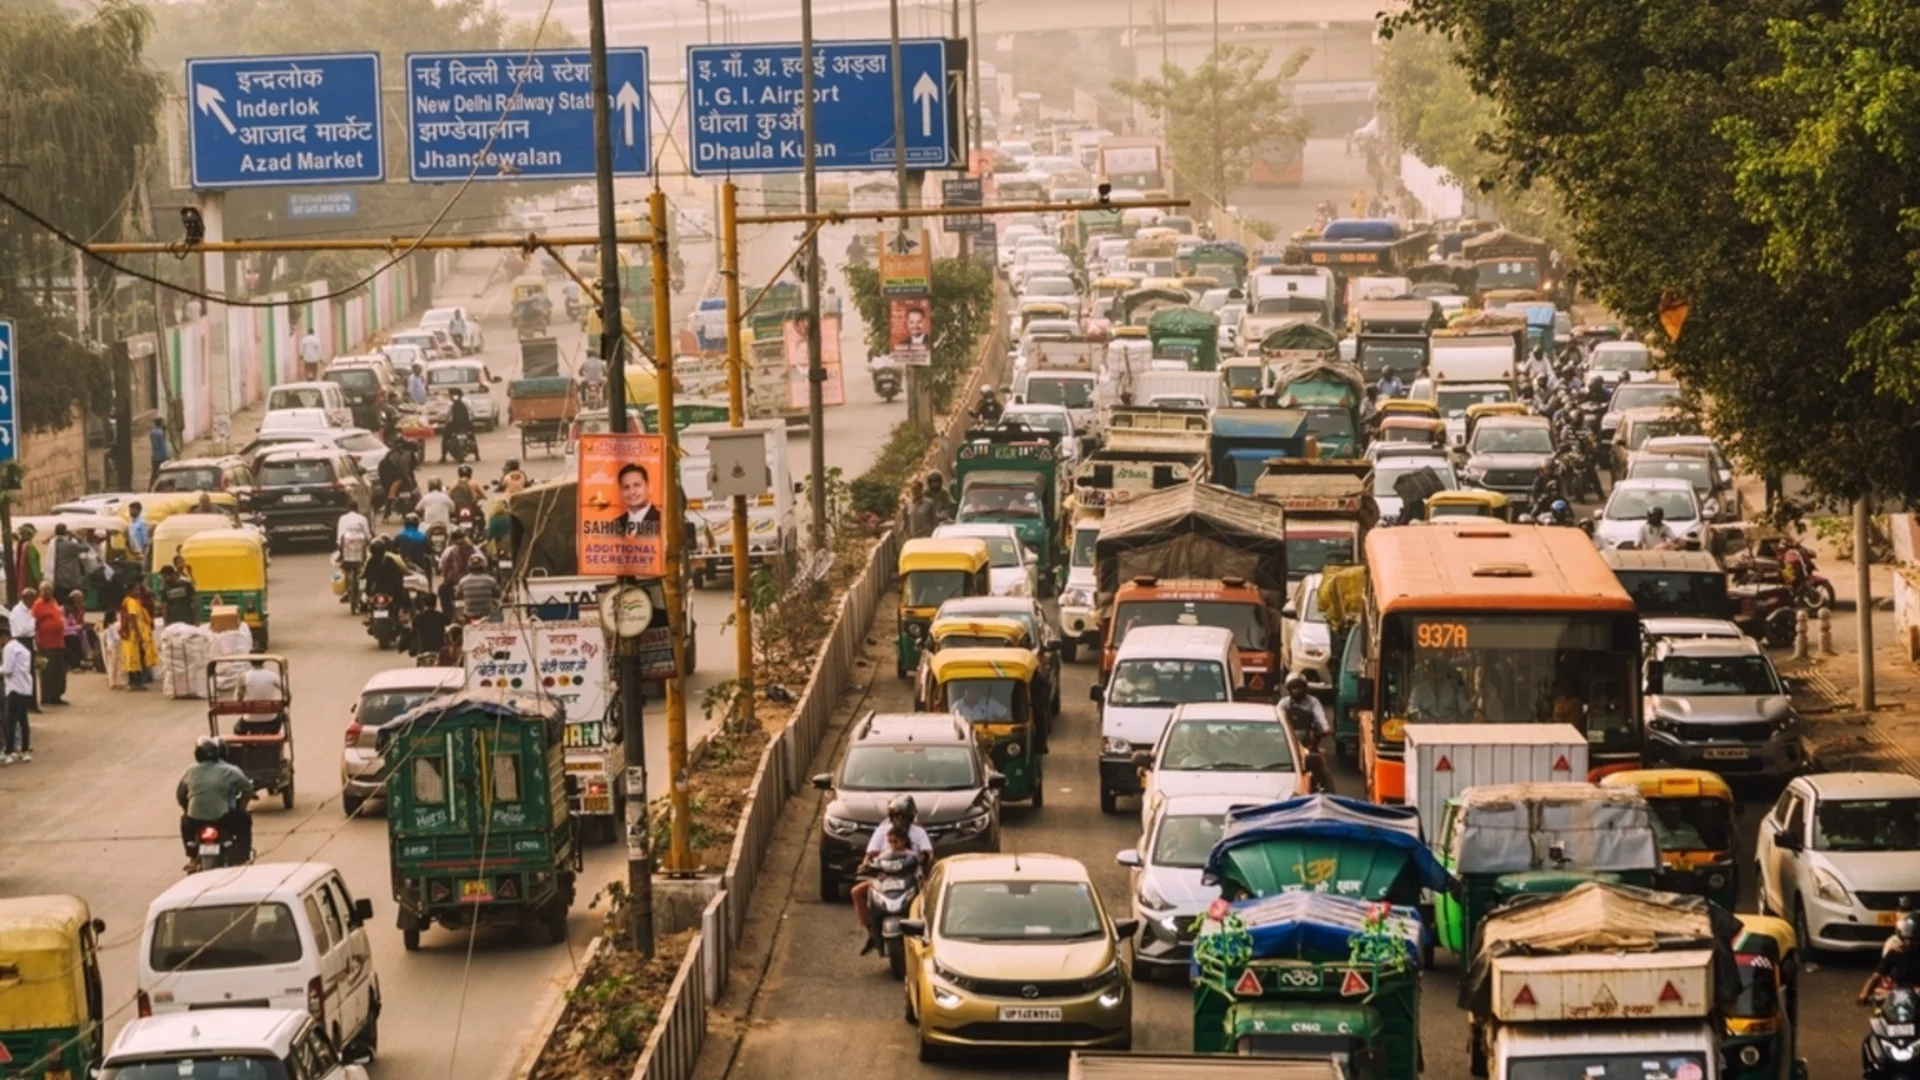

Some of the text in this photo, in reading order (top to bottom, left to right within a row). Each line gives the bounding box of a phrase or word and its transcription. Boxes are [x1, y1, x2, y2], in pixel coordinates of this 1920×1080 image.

[416, 57, 593, 90] नई दिल्ली रेलवे स्टेश
[752, 56, 777, 77] अ.
[781, 49, 827, 79] हवई
[236, 62, 324, 94] इन्द्रलोक
[236, 97, 321, 118] Inderlok
[416, 91, 615, 116] New Delhi Railway Statin
[714, 86, 738, 107] G.
[238, 115, 373, 145] आजाद मार्केट
[418, 115, 530, 142] झण्डेवालान
[698, 108, 748, 134] धौला
[240, 151, 364, 173] Azad Market
[418, 147, 562, 169] Jhandewalan
[699, 141, 774, 162] Dhaula
[585, 543, 656, 554] ADDITIONAL
[585, 554, 655, 565] SECRETARY
[1418, 623, 1467, 648] 937A
[1291, 1022, 1321, 1034] CNG
